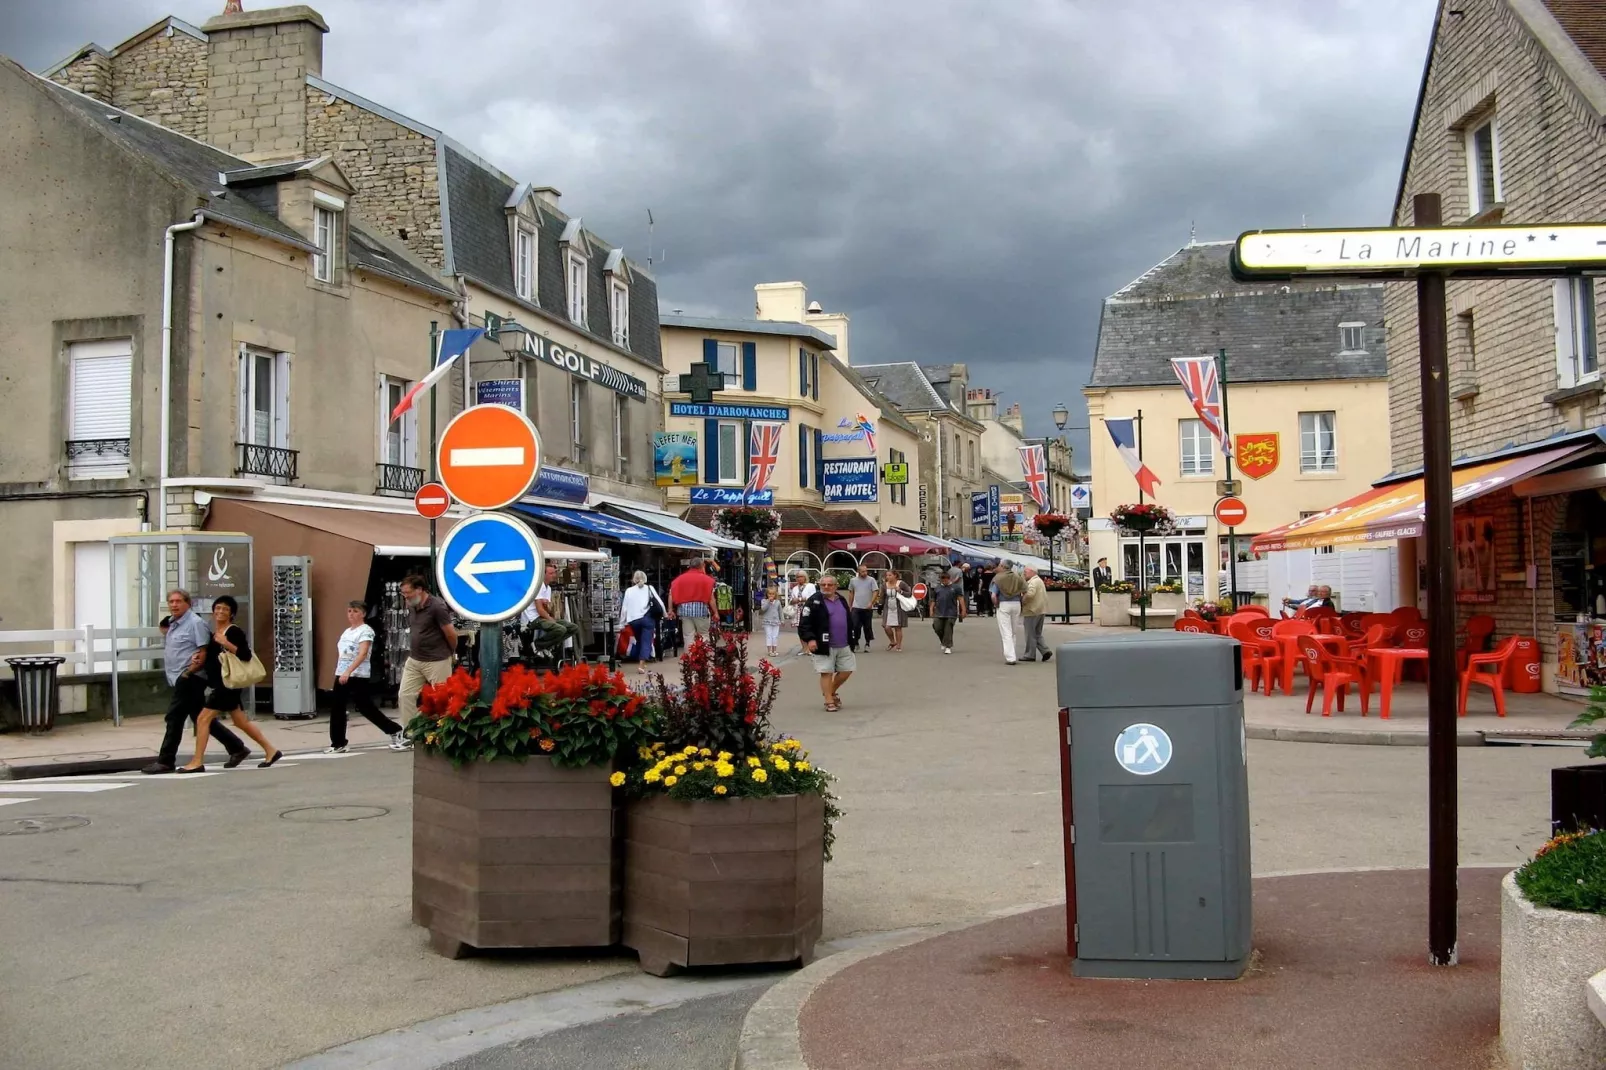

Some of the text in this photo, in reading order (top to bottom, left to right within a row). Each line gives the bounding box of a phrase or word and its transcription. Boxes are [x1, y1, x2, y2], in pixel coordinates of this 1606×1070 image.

[1339, 235, 1517, 260] La Marine
[550, 344, 600, 380] GOLF
[673, 405, 787, 419] HOTEL D'ARROMANCHES
[653, 434, 697, 448] L'EFFET MER
[823, 461, 875, 476] RESTAURANT
[693, 489, 709, 500] Le
[824, 485, 842, 497] BAR
[919, 485, 928, 533] CREPERIE
[1397, 527, 1417, 536] GLACES
